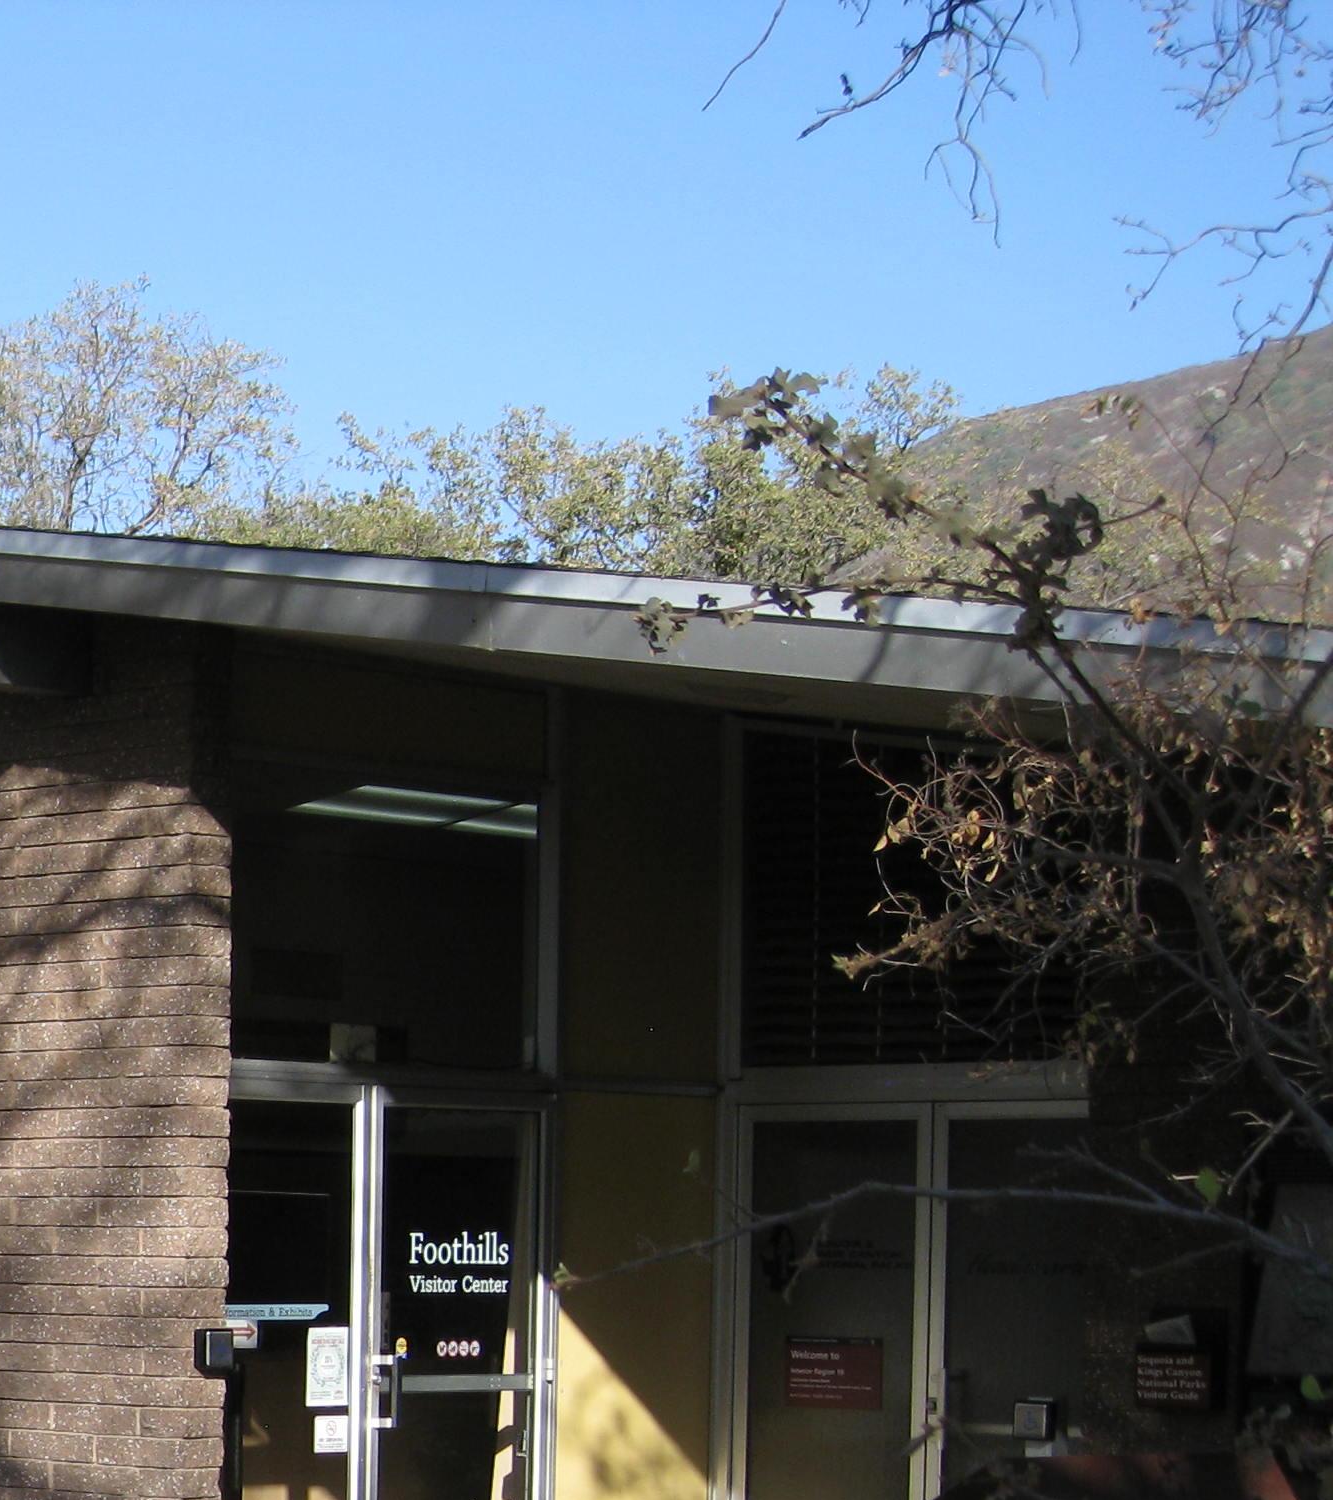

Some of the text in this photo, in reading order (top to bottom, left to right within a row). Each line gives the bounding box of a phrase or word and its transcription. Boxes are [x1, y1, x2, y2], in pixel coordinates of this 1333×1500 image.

[408, 1230, 510, 1265] Foothills
[408, 1274, 510, 1293] Visitor Center
[790, 1350, 840, 1360] Welcome to
[1136, 1355, 1195, 1366] Sequoia and
[1137, 1367, 1203, 1377] Kings Canyon
[1137, 1378, 1206, 1389] National Parks
[1137, 1390, 1199, 1401] Visitor Guide
